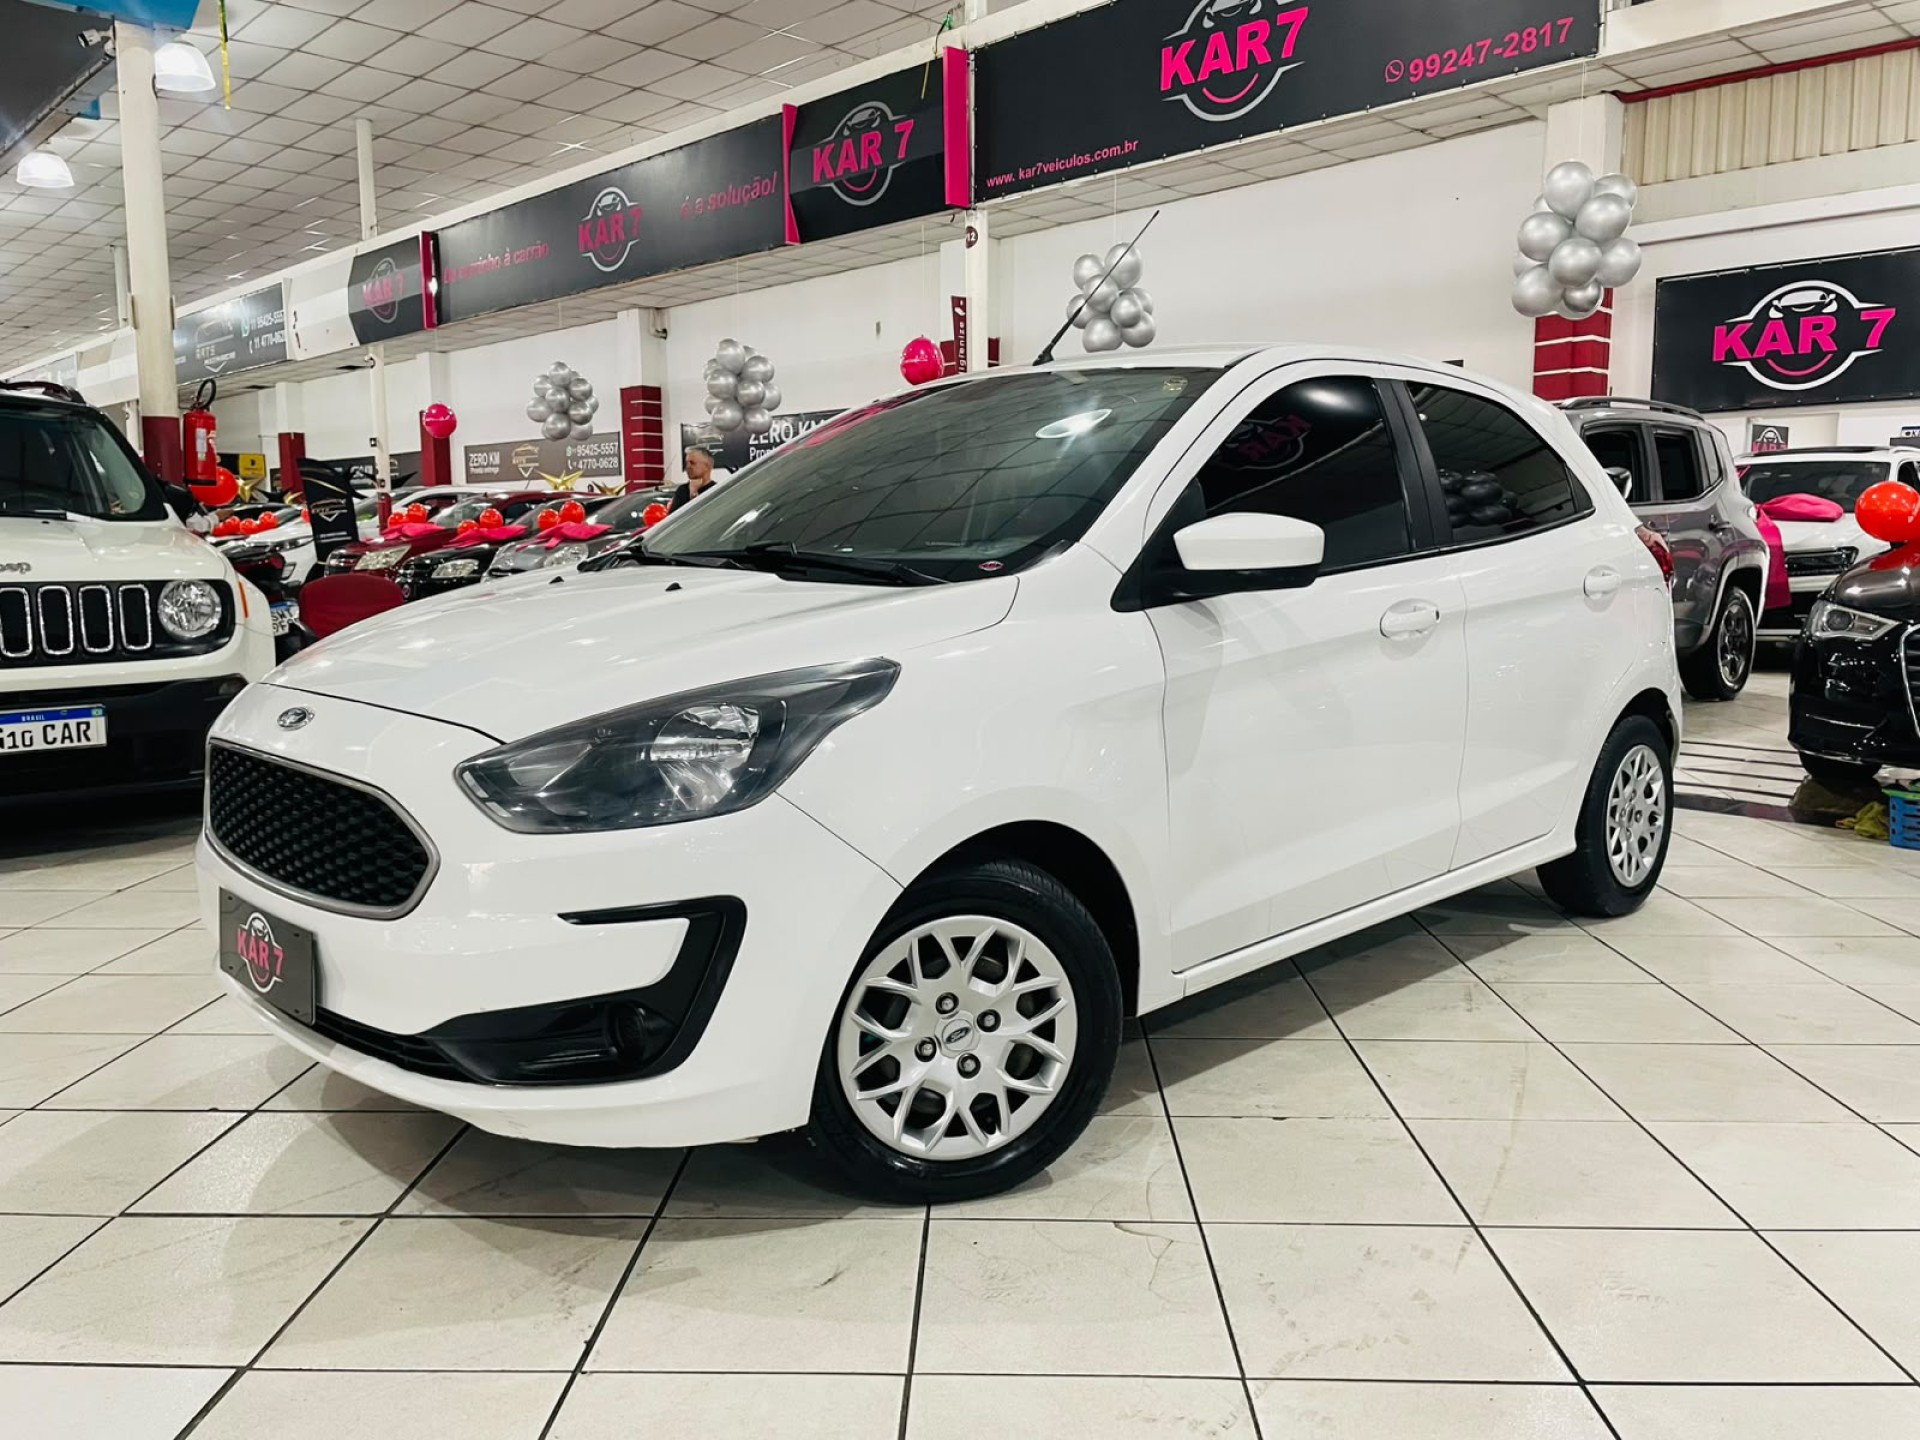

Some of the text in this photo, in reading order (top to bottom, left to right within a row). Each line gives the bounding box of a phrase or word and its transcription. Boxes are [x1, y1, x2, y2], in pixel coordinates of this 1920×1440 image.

[1409, 17, 1574, 83] 99247-2817
[812, 119, 914, 183] KAR 7
[986, 139, 1139, 188] www. kar7veiculos.com.br
[695, 197, 703, 214] a
[708, 171, 777, 211] solução!
[578, 207, 645, 252] KAR 7
[1713, 308, 1896, 362] KAR 7
[469, 453, 488, 468] ZERO
[43, 721, 91, 745] CAR
[237, 928, 284, 976] KAR 7
